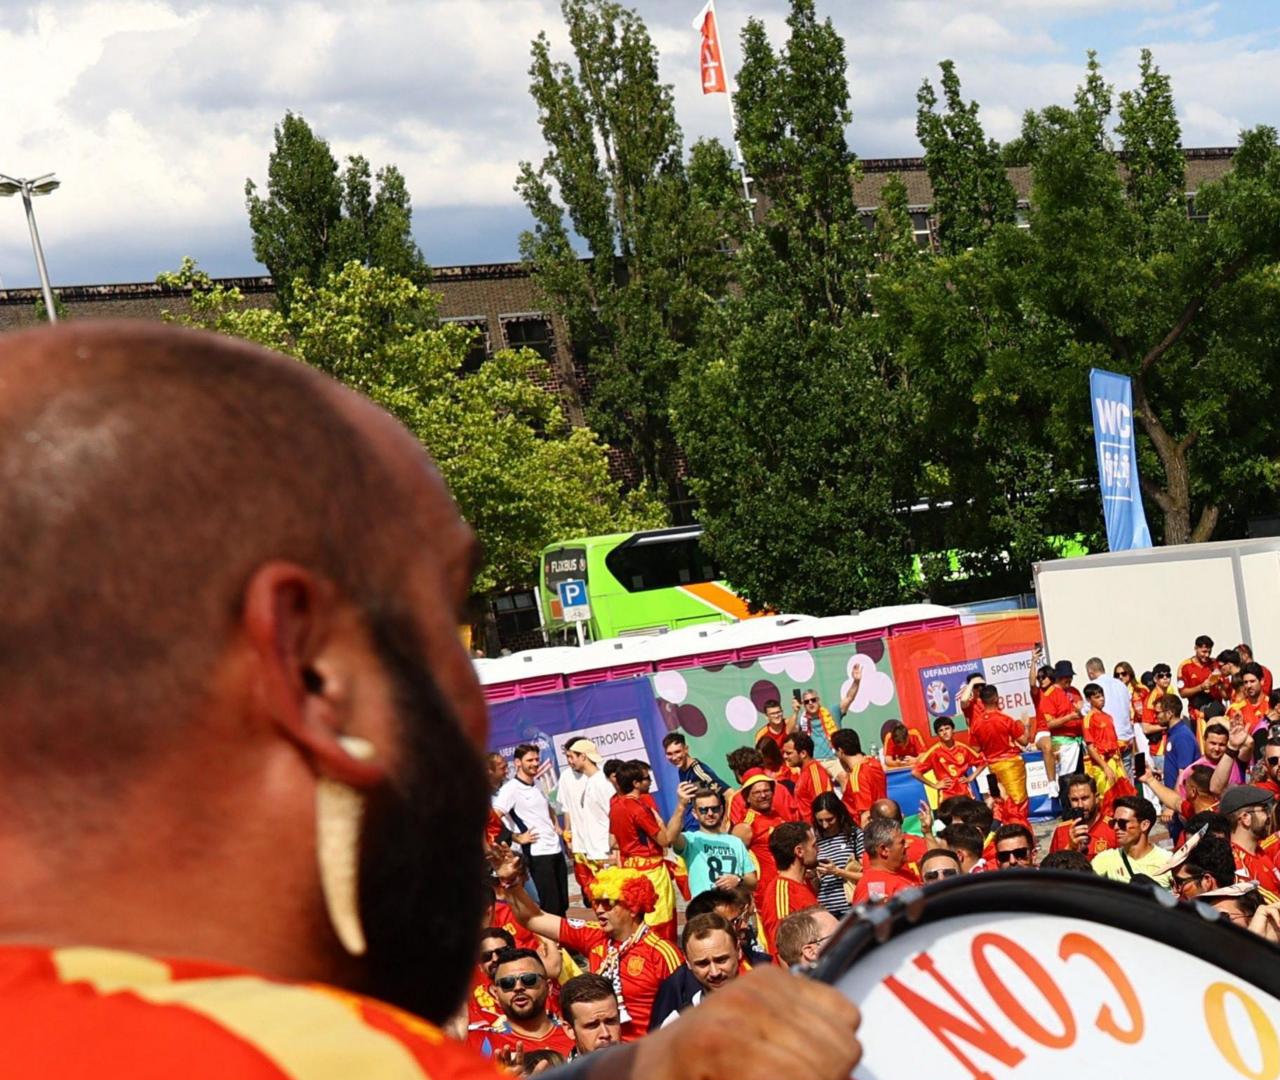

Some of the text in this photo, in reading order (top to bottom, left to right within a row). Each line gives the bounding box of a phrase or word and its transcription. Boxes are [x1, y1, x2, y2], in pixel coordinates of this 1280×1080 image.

[1097, 398, 1131, 438] WC
[565, 586, 579, 605] P
[998, 692, 1033, 711] BERL
